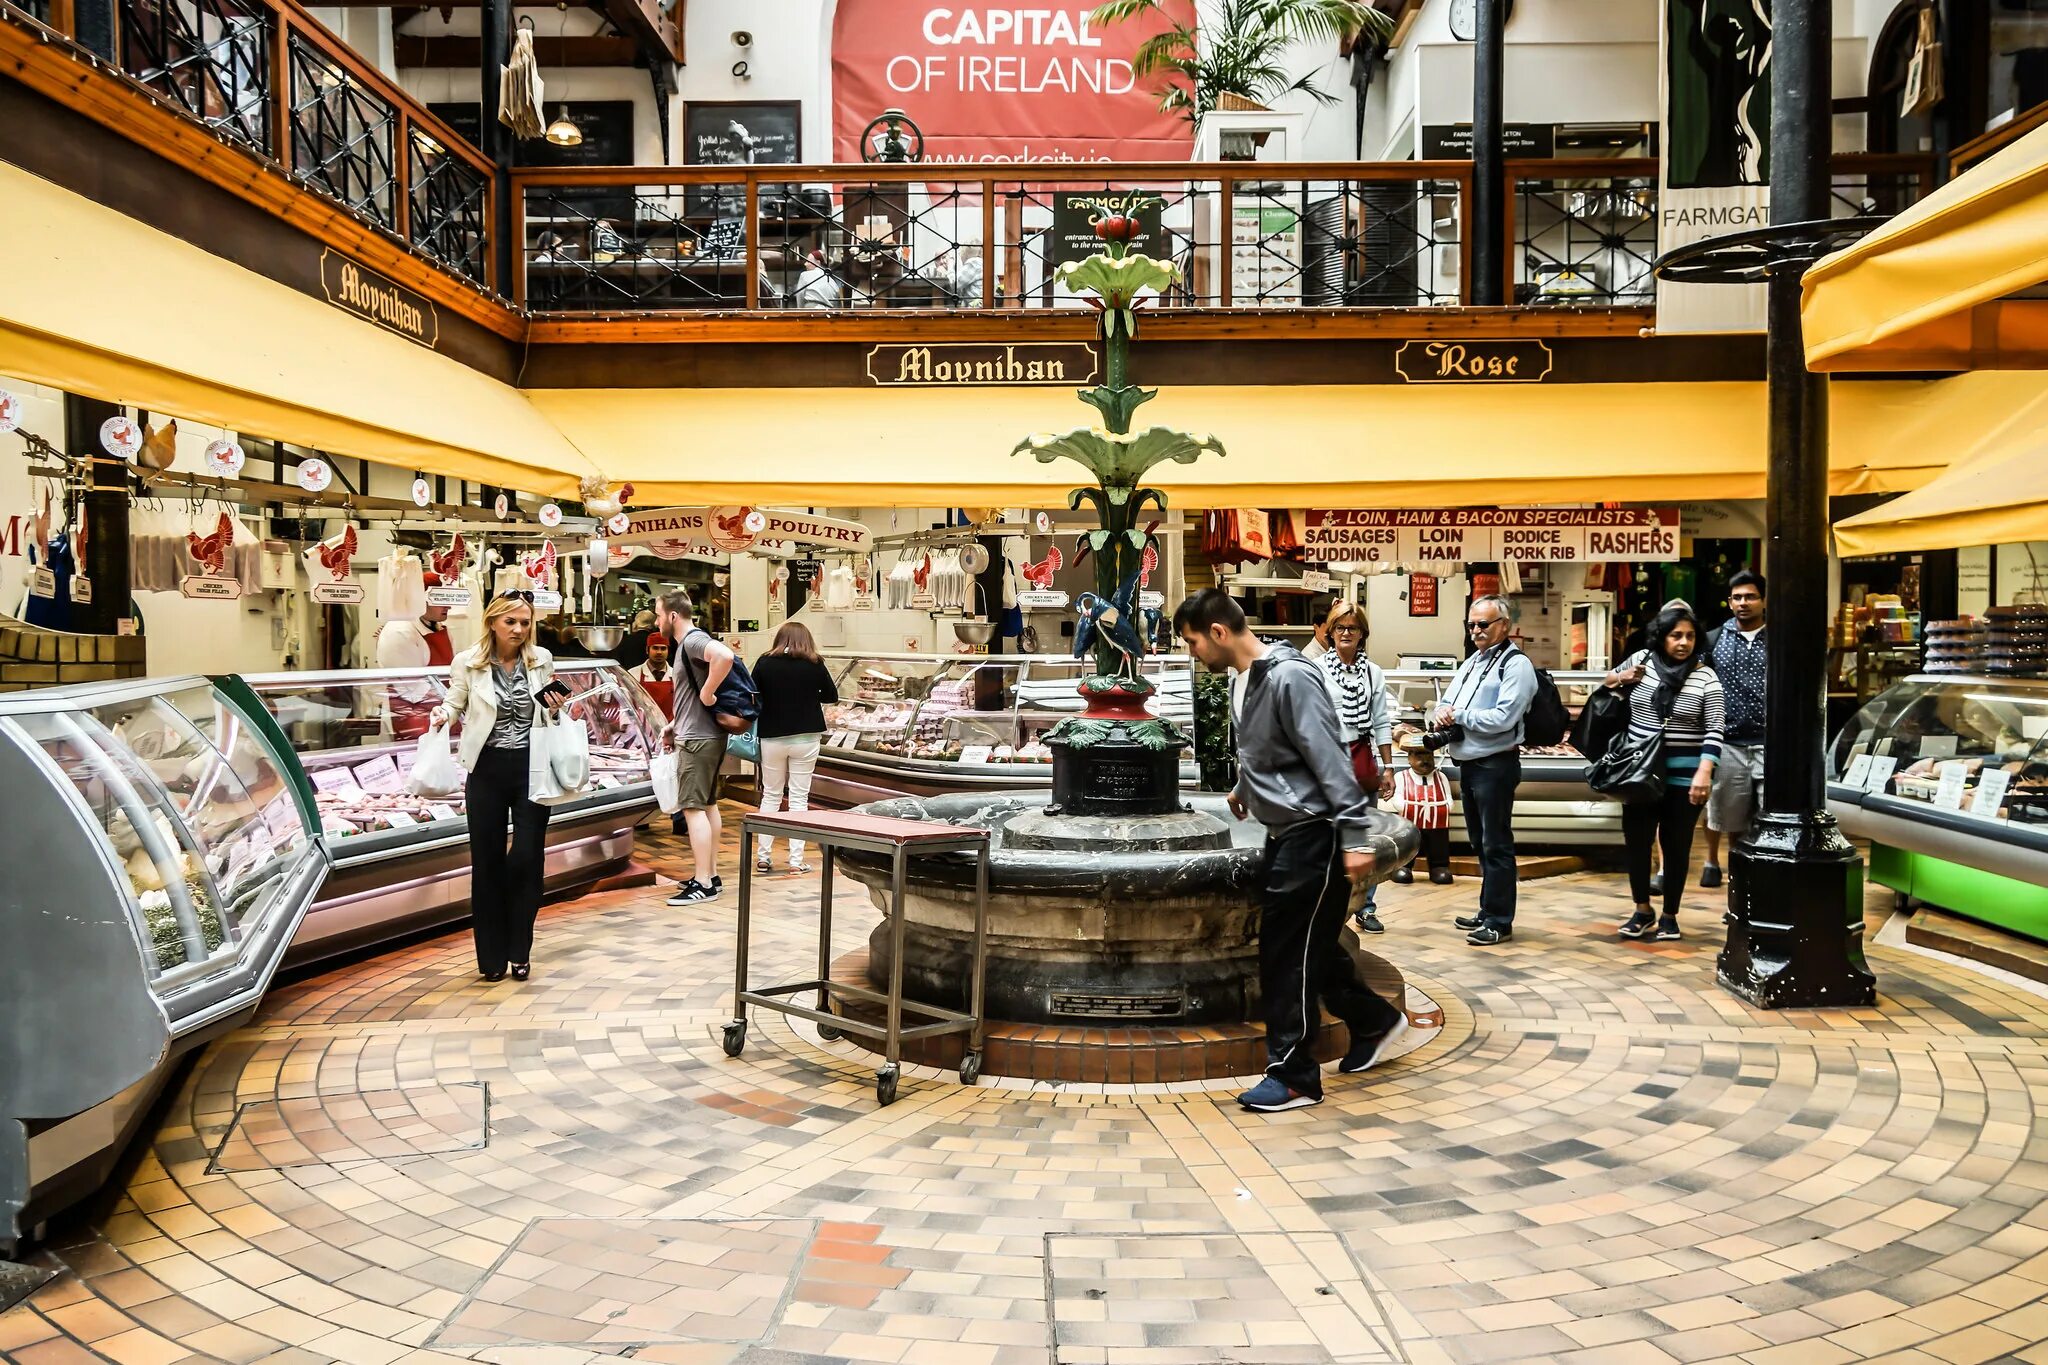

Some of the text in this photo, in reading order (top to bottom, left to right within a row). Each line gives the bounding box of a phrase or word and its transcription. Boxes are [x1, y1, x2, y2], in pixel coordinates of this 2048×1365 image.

[922, 8, 1102, 47] CAPITAL
[886, 55, 1136, 95] OF IRELAND
[1663, 206, 1770, 228] FARMGAT
[338, 262, 423, 336] Moynihan
[894, 345, 1065, 383] Moynihan
[1425, 342, 1519, 377] Rose
[603, 515, 703, 538] YNIHANS
[1346, 510, 1636, 527] LOIN, HAM & BACON SPECIALISTS
[768, 518, 865, 543] POULTRY
[1304, 529, 1396, 544] SAUSAGES
[1419, 528, 1464, 543] LOIN
[1503, 530, 1561, 544] BODICE
[1419, 546, 1461, 560] HAM
[1503, 547, 1576, 560] PORK RIB
[1590, 532, 1674, 554] RASHERS
[1305, 547, 1380, 562] PUDDING
